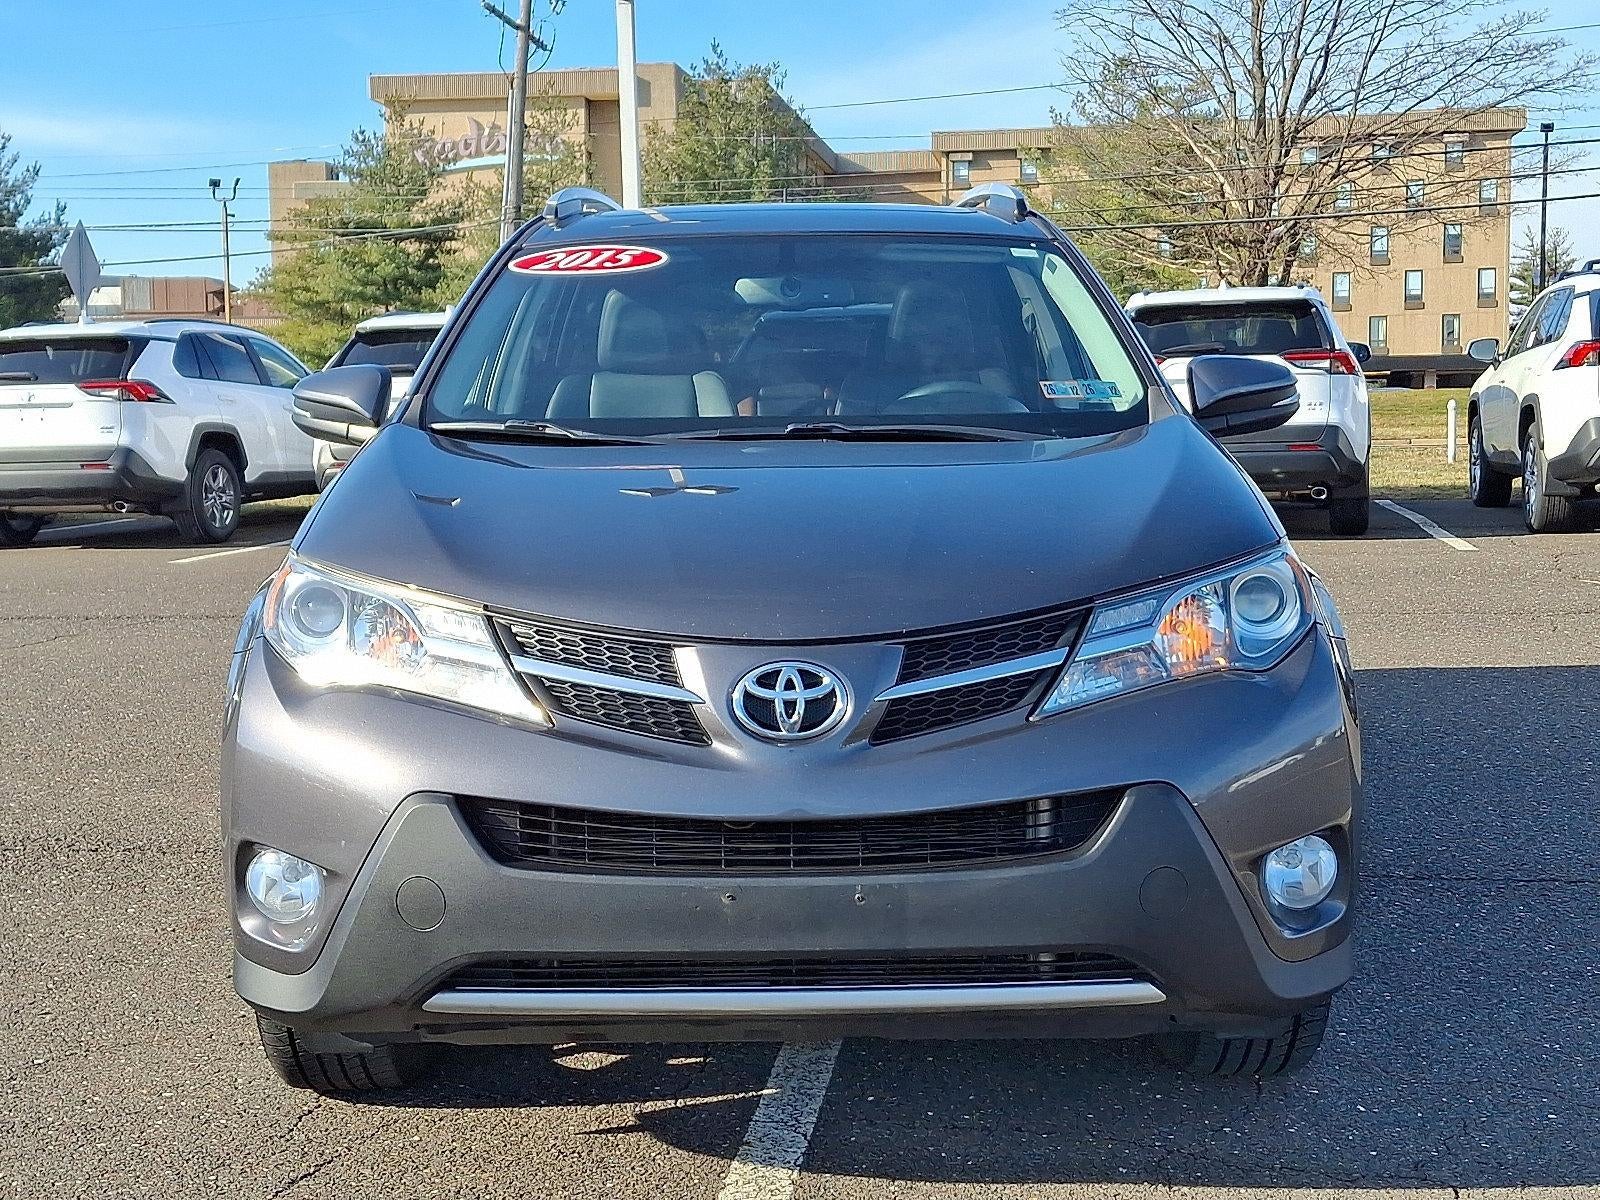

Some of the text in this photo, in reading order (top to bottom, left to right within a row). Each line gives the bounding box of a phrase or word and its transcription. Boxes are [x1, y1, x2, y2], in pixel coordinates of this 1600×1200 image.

[411, 116, 565, 168] Radisn
[528, 250, 643, 270] 2015
[1044, 384, 1056, 395] 26
[1082, 384, 1096, 395] 26
